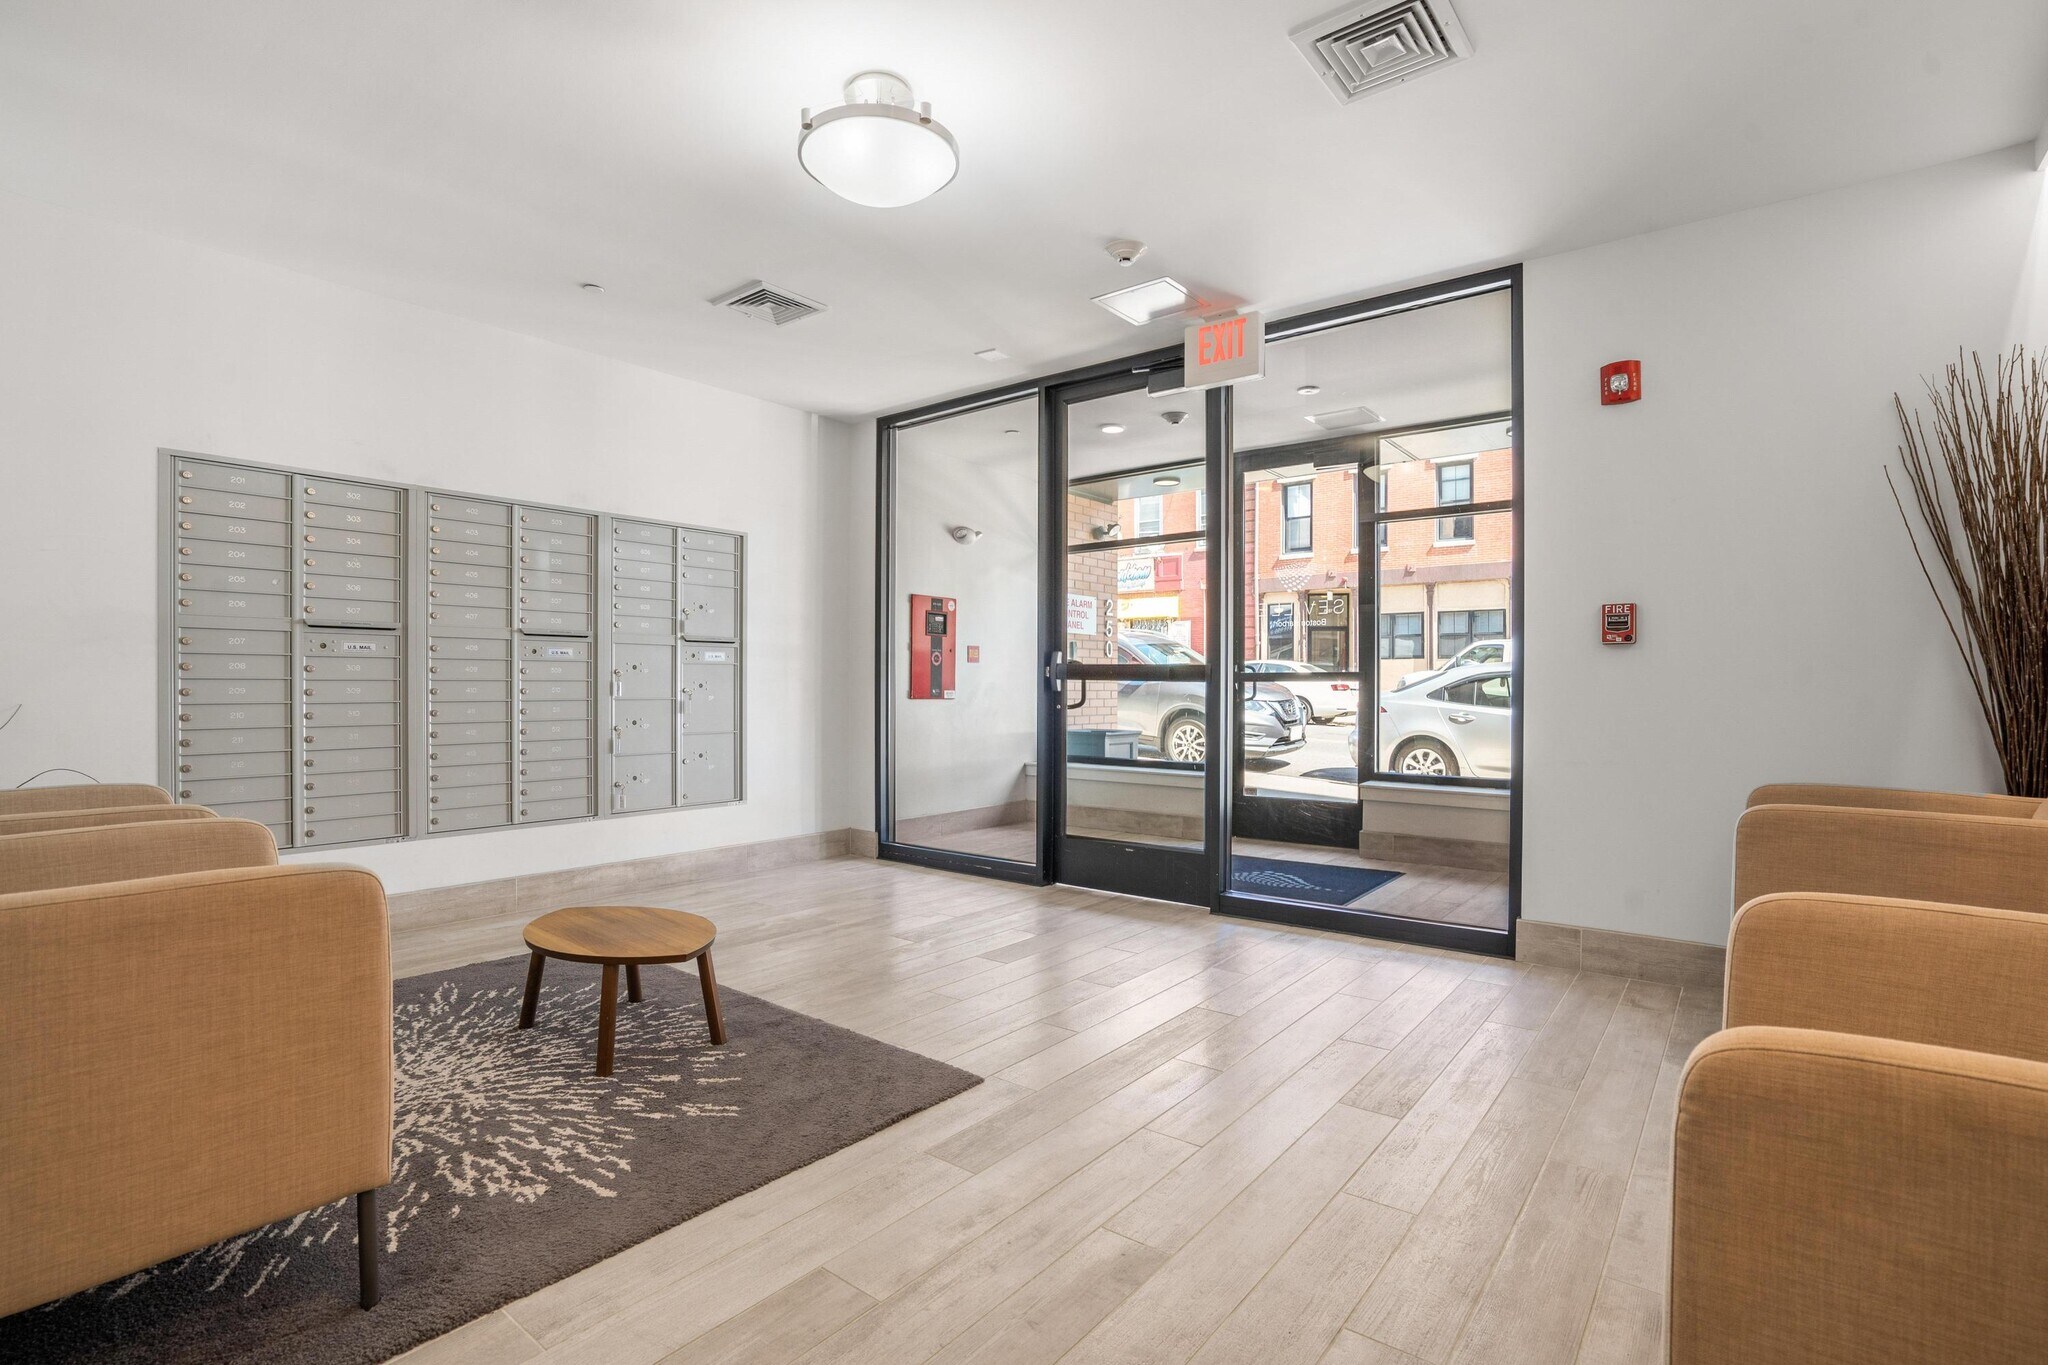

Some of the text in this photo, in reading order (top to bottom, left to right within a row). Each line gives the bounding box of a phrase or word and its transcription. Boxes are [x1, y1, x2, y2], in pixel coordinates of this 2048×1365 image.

[1198, 317, 1247, 366] EXIT
[231, 476, 246, 485] 201
[346, 492, 361, 500] 302
[228, 501, 246, 509] 202
[346, 515, 361, 523] 303
[228, 526, 246, 534] 203
[228, 575, 246, 583] 205
[346, 583, 361, 592] 306
[228, 600, 246, 608] 206
[1071, 599, 1093, 609] ALARM
[346, 607, 361, 615] 307
[1605, 604, 1631, 614] FIRE
[1067, 610, 1089, 619] NTROL
[1067, 620, 1085, 630] ANEL
[228, 637, 246, 645] 207
[228, 662, 246, 670] 208
[346, 664, 361, 672] 308
[228, 687, 246, 695] 209
[231, 736, 243, 744] 211
